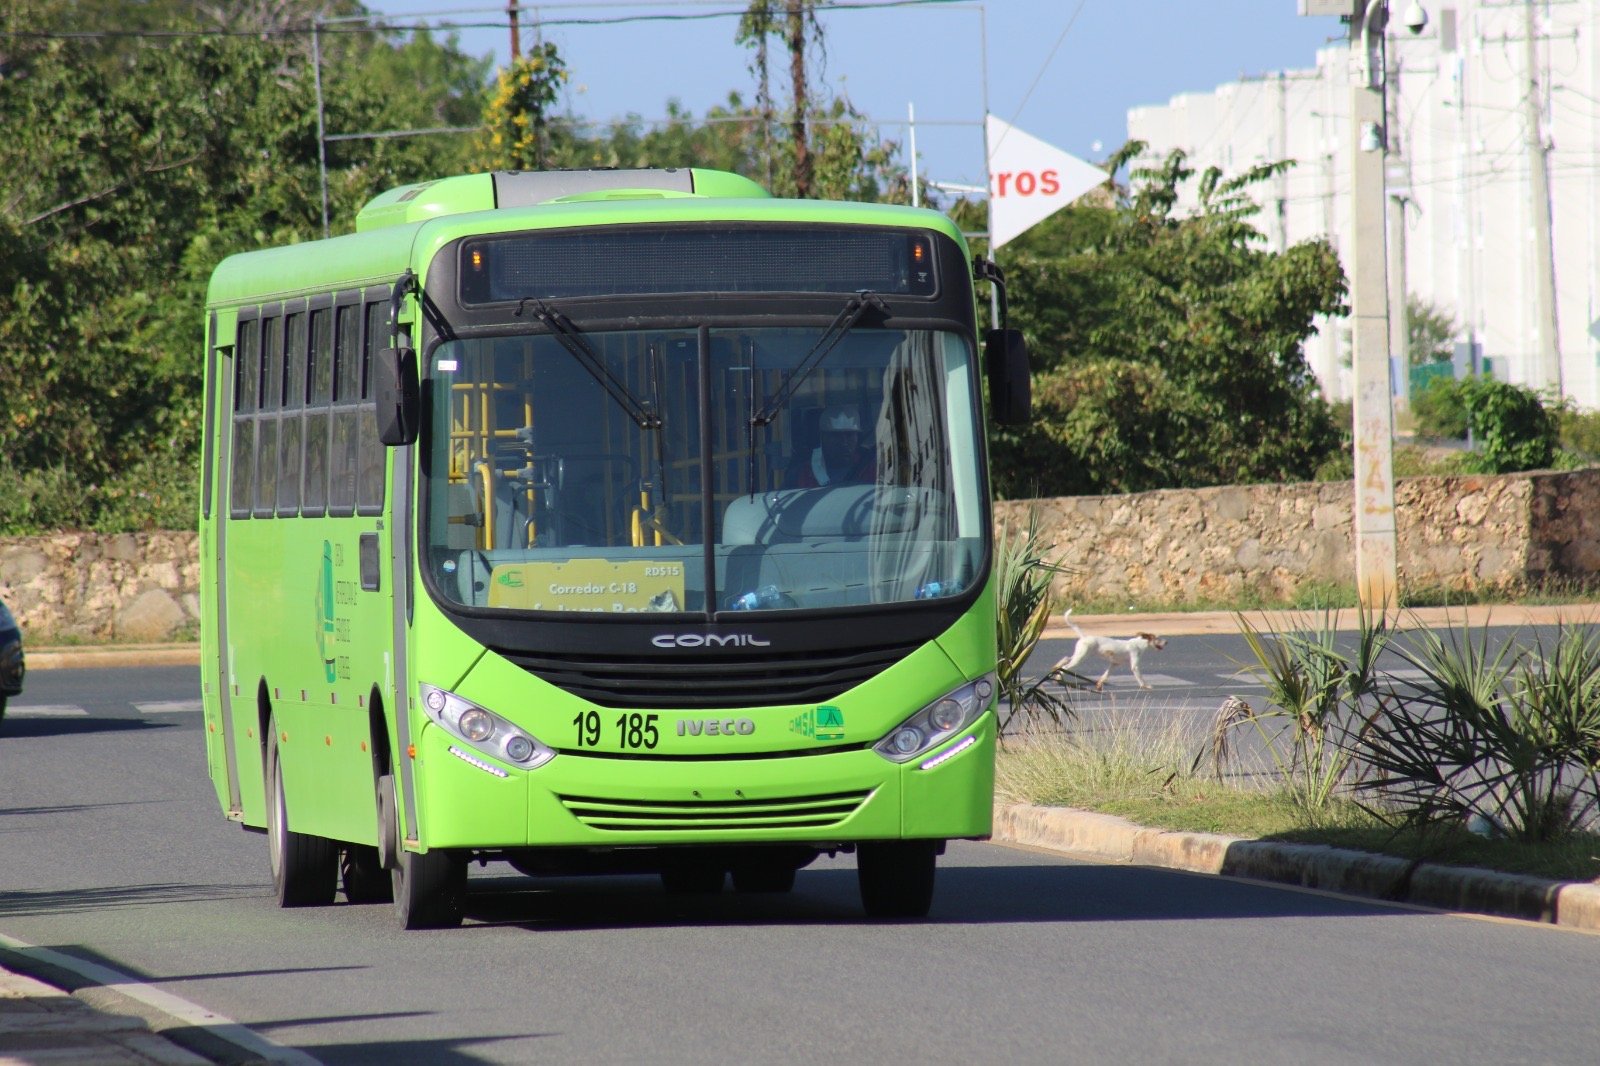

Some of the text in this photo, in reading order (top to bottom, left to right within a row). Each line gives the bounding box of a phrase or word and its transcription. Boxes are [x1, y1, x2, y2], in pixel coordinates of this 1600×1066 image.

[990, 170, 1060, 197] ros
[549, 582, 637, 595] Corredor C-18
[651, 634, 771, 648] COMIL
[573, 710, 659, 749] 19 185
[676, 718, 755, 736] IVECO
